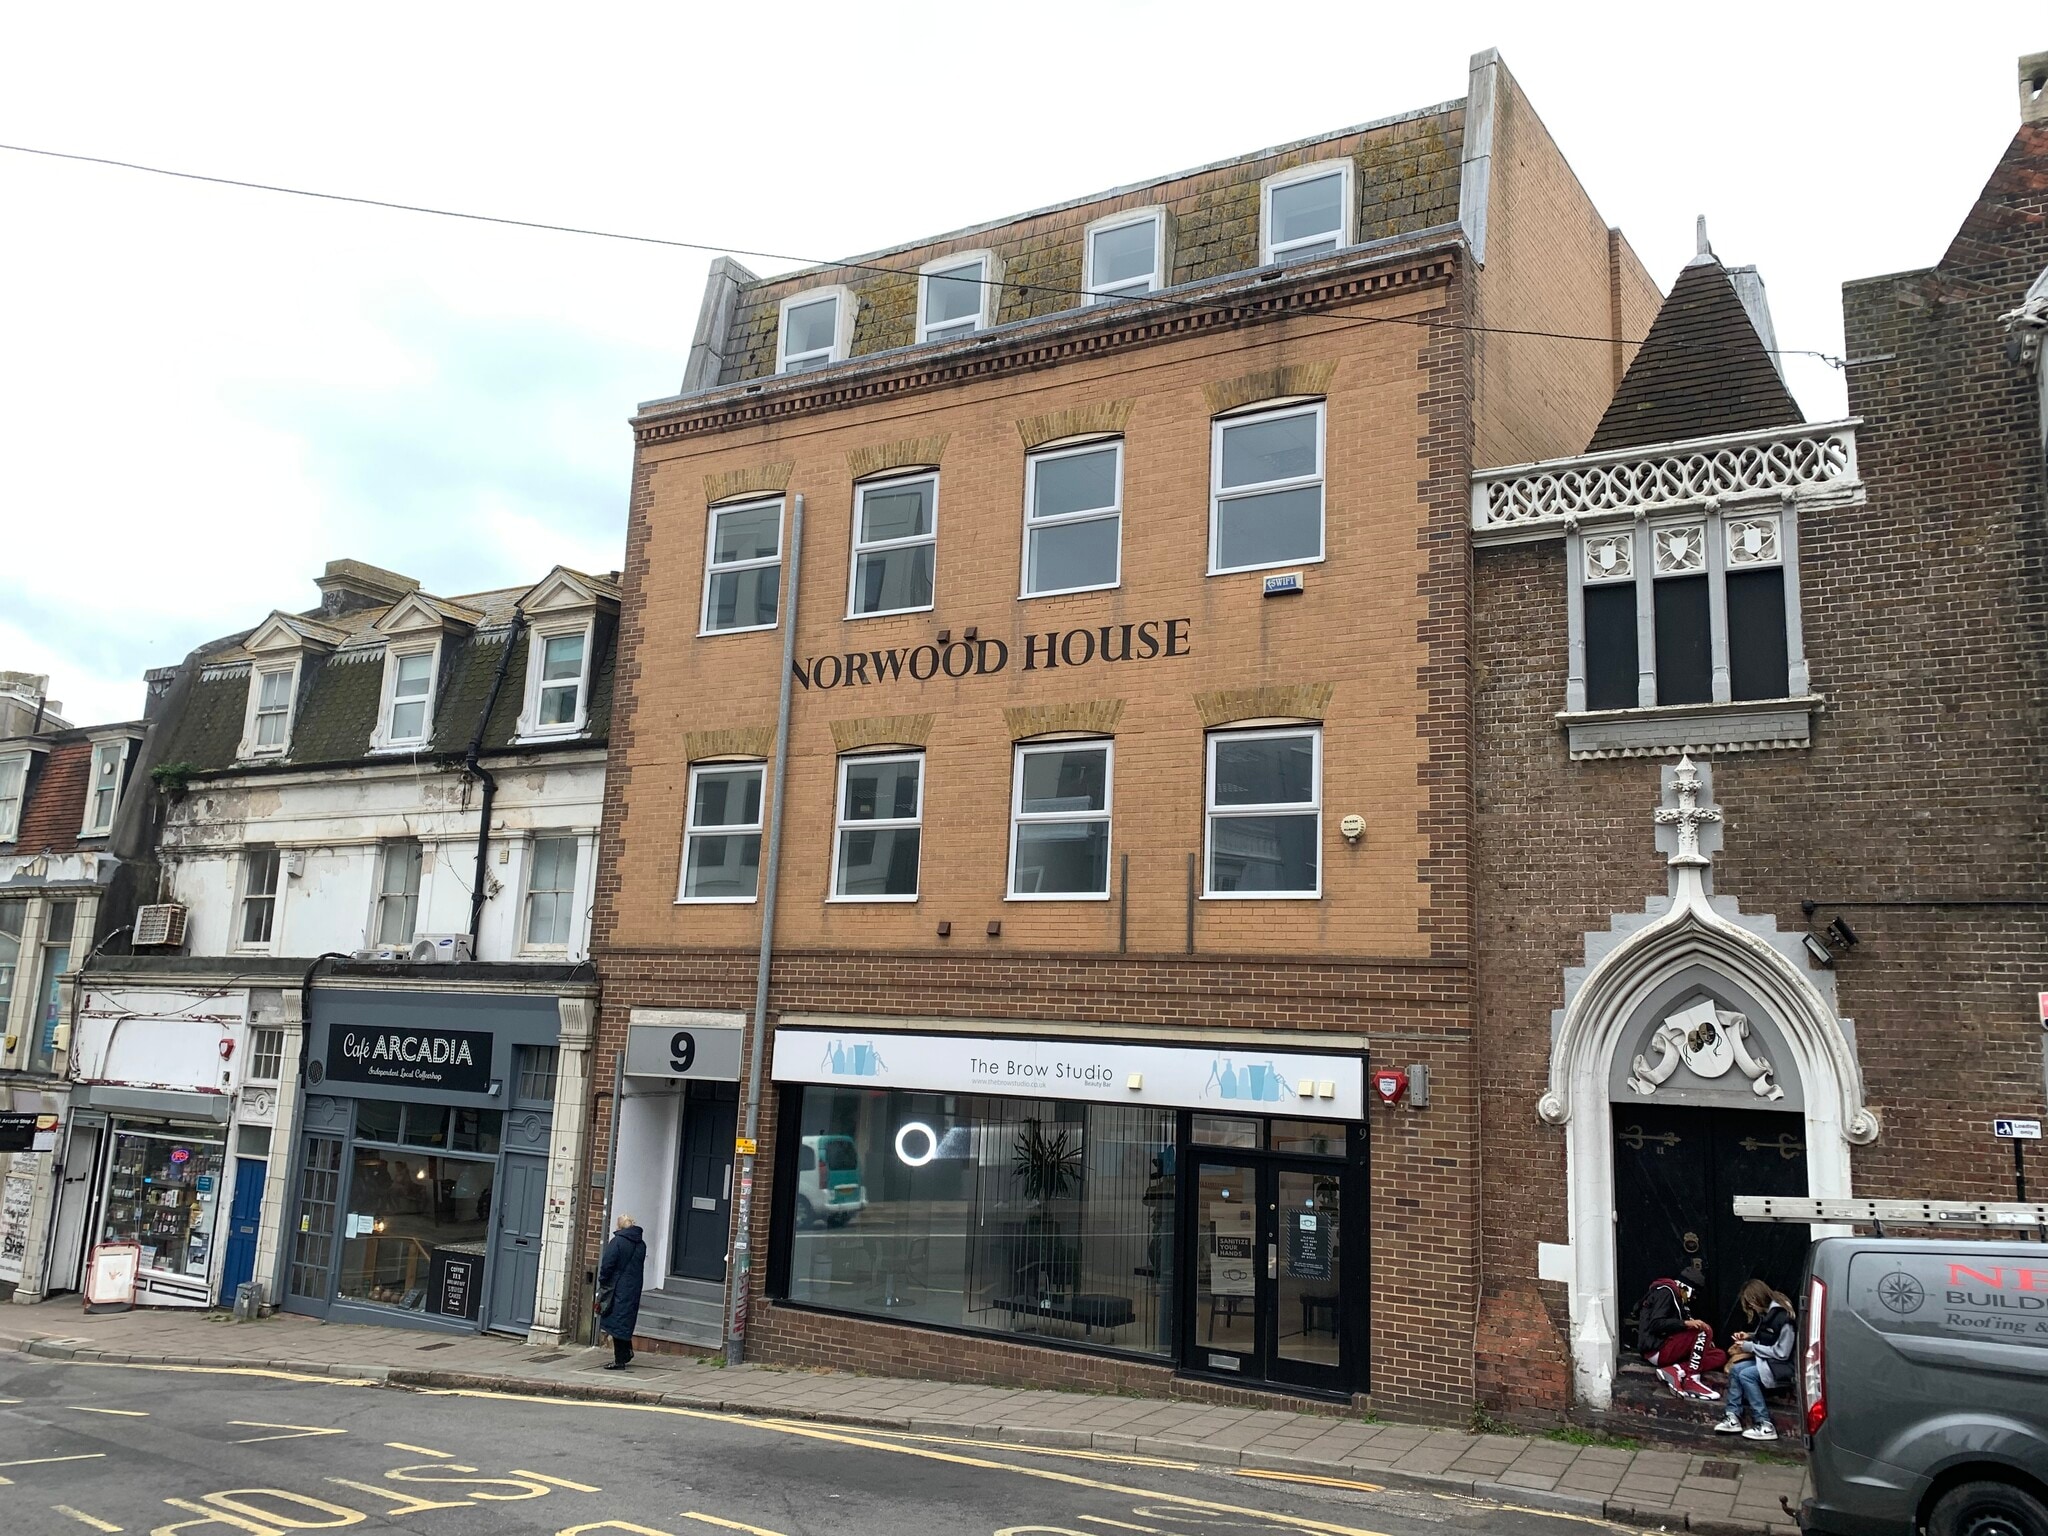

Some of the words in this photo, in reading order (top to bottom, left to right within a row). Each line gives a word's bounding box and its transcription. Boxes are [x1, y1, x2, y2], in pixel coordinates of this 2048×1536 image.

[1270, 575, 1295, 588] SWIFT
[792, 638, 1009, 691] NORWOOD
[1022, 617, 1192, 671] HOUSE
[343, 1032, 371, 1065] Café
[372, 1034, 473, 1066] ARCADIA
[670, 1031, 696, 1073] 9
[367, 1065, 400, 1078] Independent
[399, 1068, 415, 1079] Local
[414, 1068, 443, 1082] Coffeeshop
[971, 1058, 999, 1074] The
[1007, 1060, 1049, 1076] Brow
[1055, 1062, 1113, 1081] Studio
[972, 1077, 1047, 1089] www.thebrowstudio.co.uk
[1084, 1080, 1102, 1088] Beauty
[1359, 1128, 1367, 1141] 9
[2014, 1122, 2039, 1131] Loading
[1946, 1291, 2048, 1309] BUILD
[1946, 1313, 2027, 1333] Roofing
[1689, 1351, 1702, 1370] AIR
